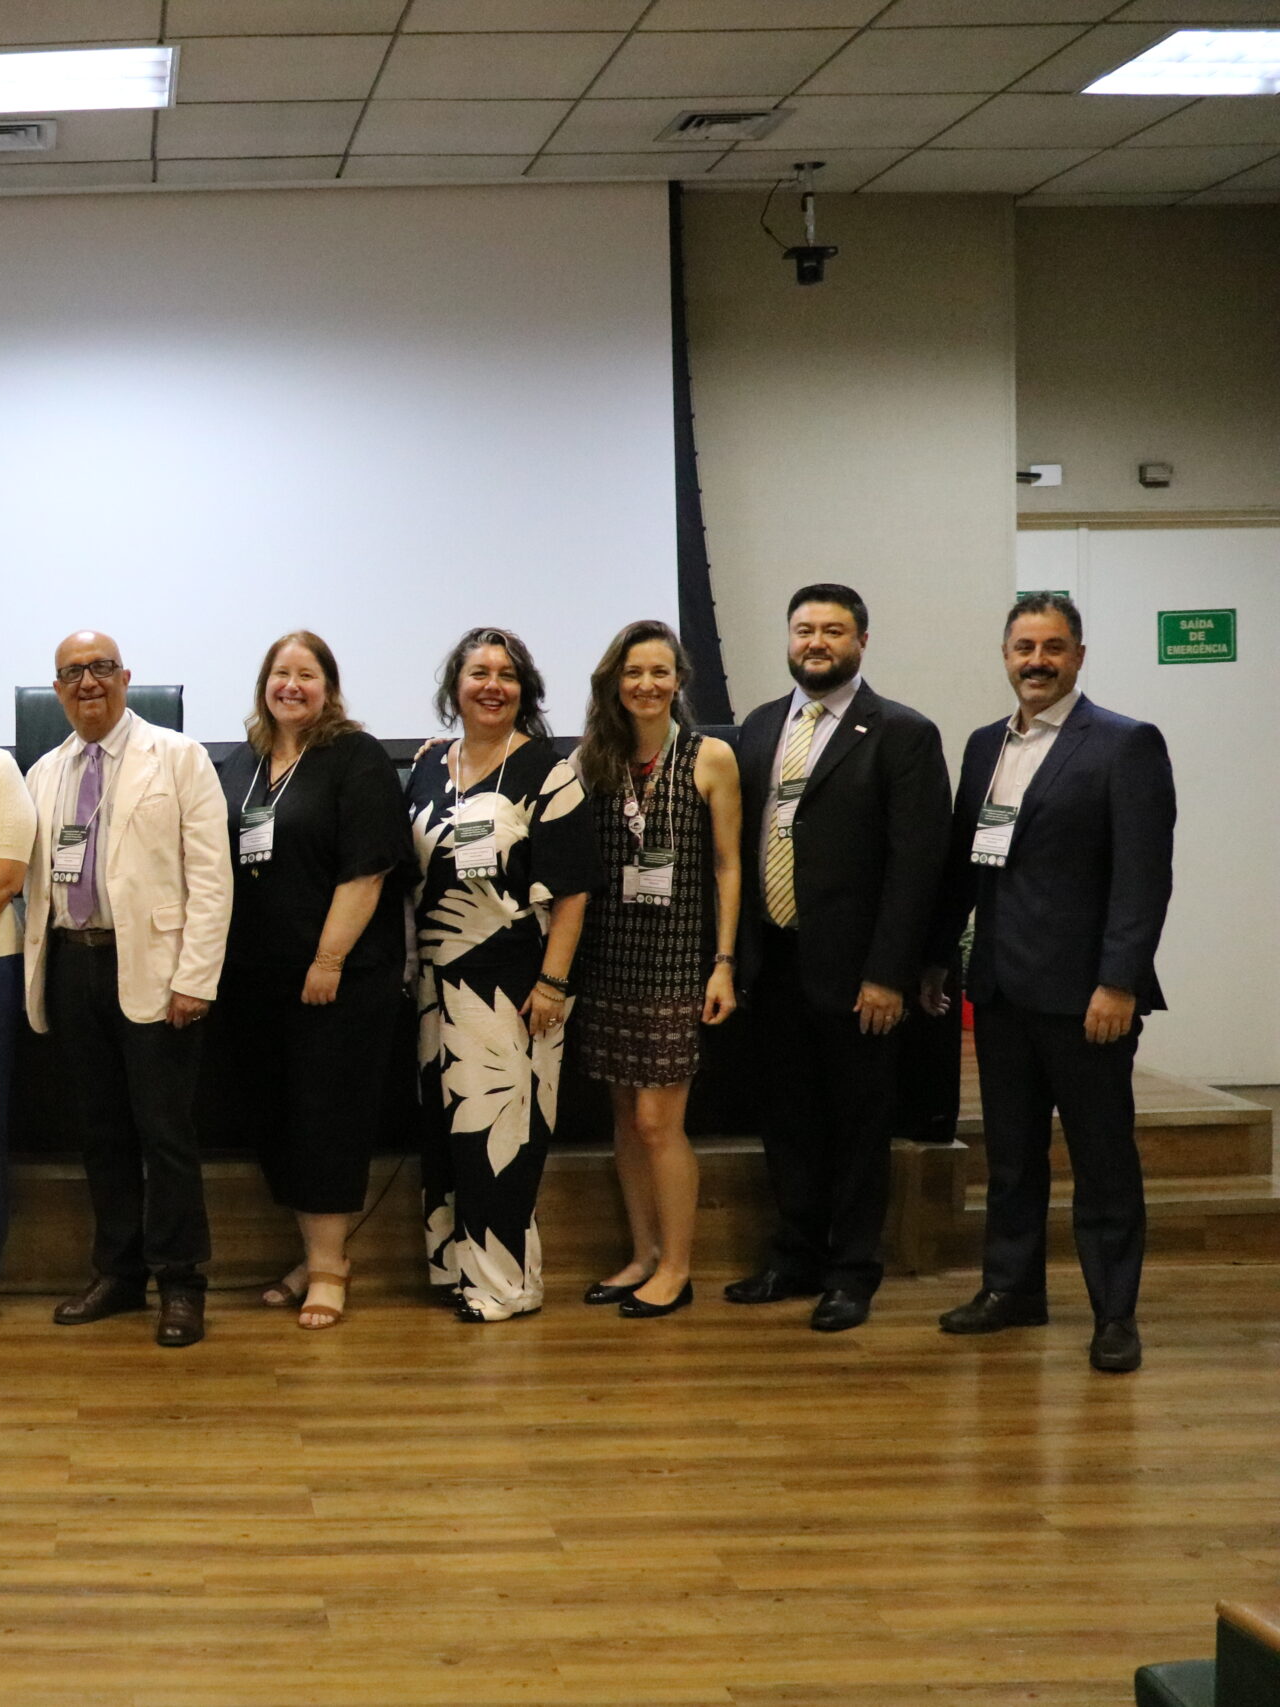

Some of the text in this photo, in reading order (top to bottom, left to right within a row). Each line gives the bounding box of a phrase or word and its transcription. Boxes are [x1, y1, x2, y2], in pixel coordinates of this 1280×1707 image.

[1180, 617, 1214, 629] SAÍDA
[1189, 631, 1206, 641] DE
[1167, 642, 1228, 655] EMERGÊNCIA
